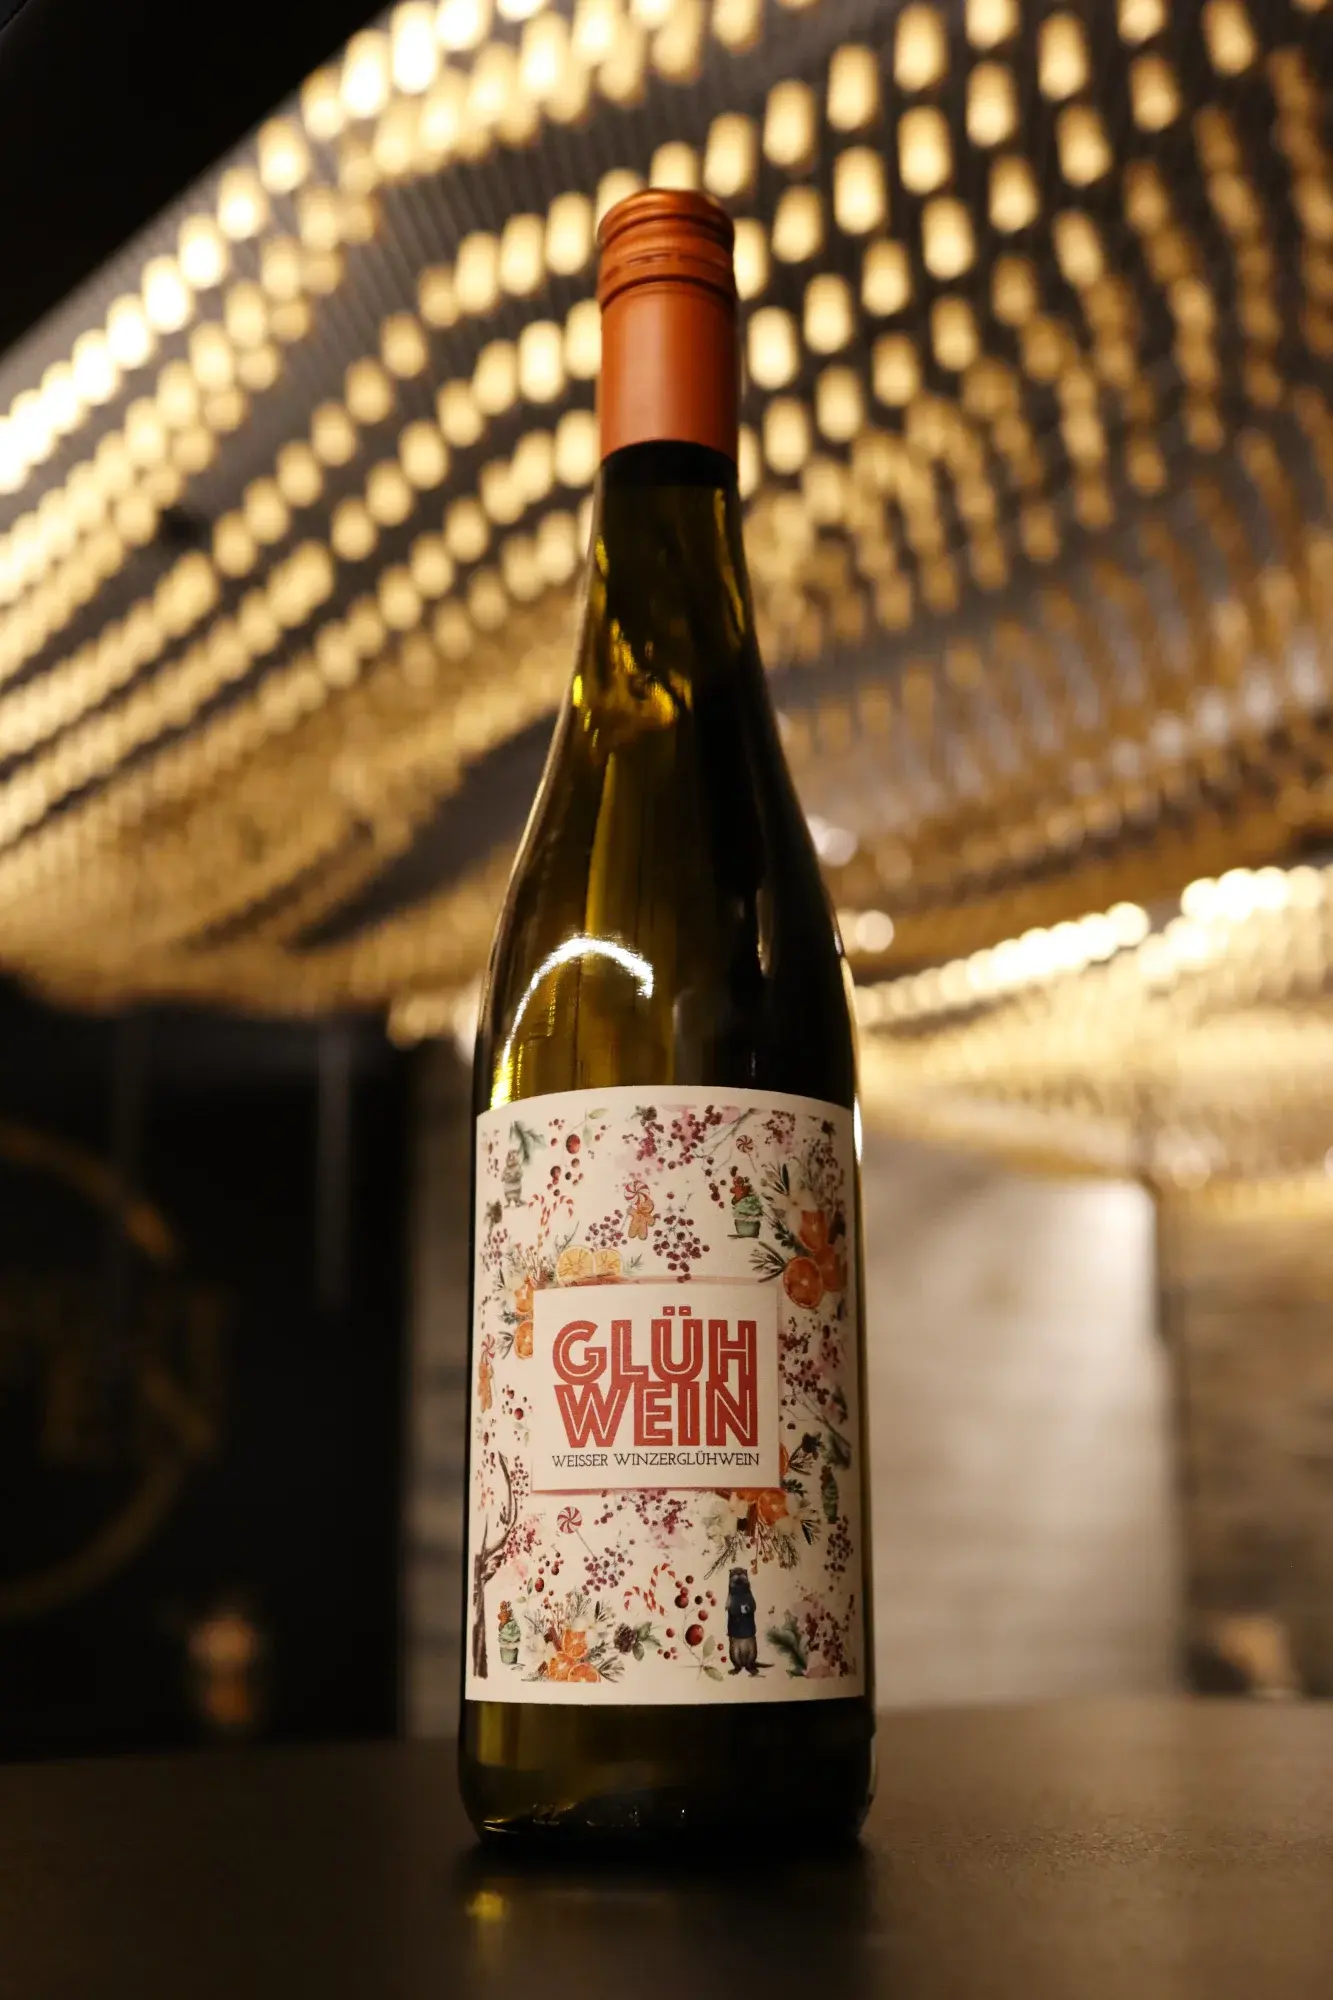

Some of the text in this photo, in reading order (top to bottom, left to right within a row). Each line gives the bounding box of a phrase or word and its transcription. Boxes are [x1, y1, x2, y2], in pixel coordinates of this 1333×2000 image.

[552, 1305, 757, 1386] GLÜH
[554, 1381, 758, 1448] WEIN
[552, 1450, 760, 1468] WEISSER WINZERGLÜHWEIN
